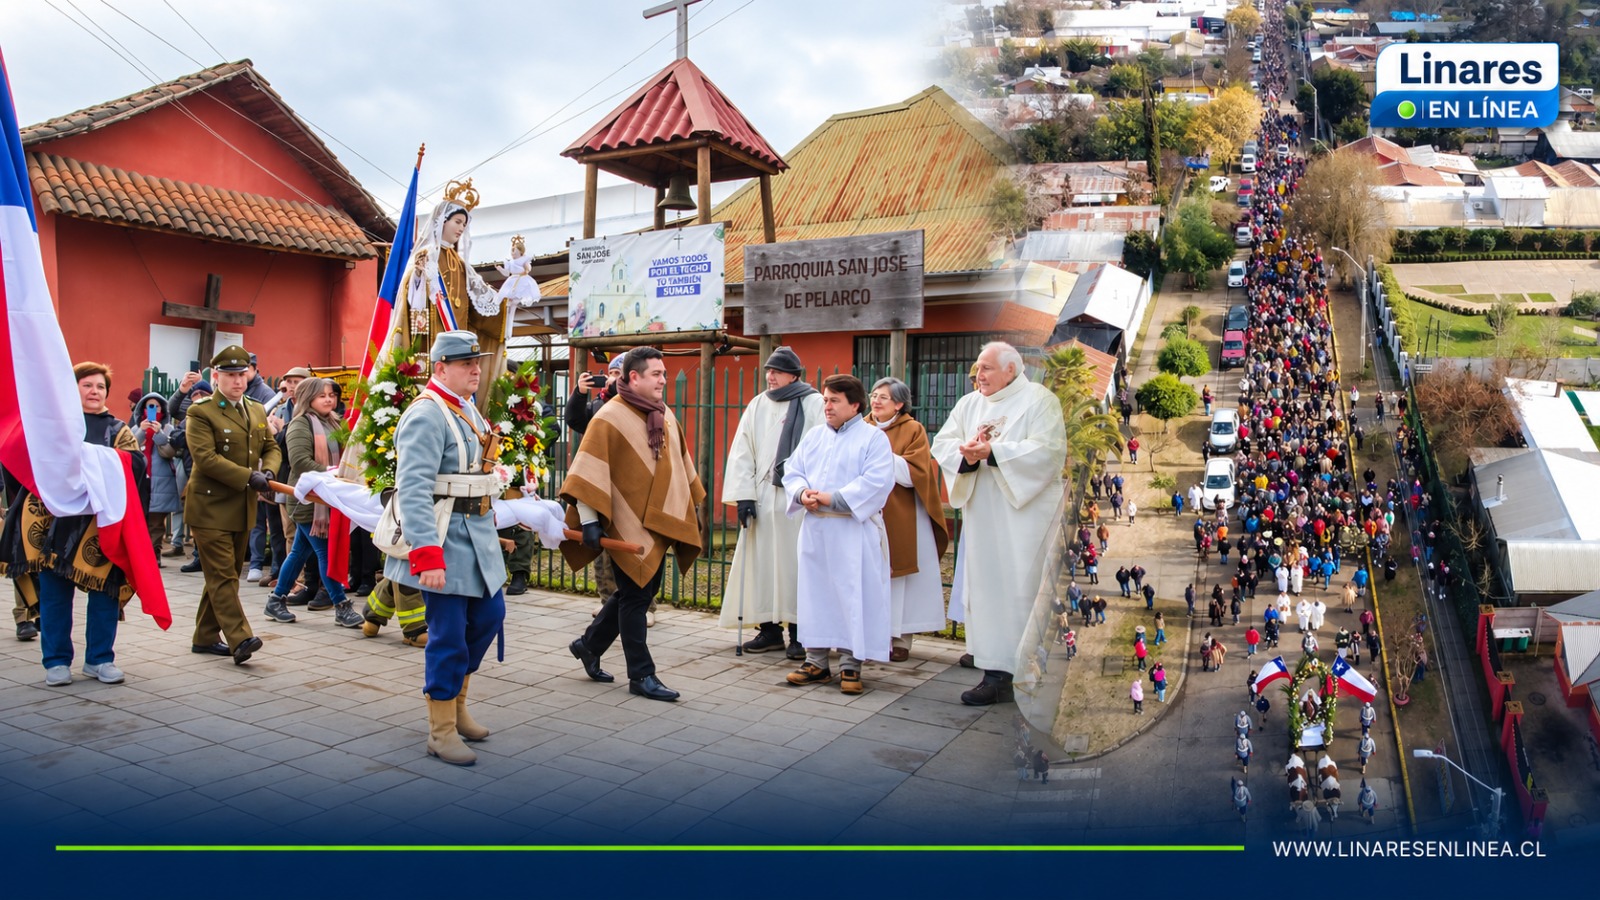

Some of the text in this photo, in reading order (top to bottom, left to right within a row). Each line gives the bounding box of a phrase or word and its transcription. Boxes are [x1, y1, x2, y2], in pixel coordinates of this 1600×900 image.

[576, 252, 591, 260] SAN
[652, 256, 679, 266] VAMOS
[754, 254, 909, 283] PARROQUIA SAN JOSE
[663, 285, 695, 296] SUMAS
[784, 288, 871, 309] DE PELARCO
